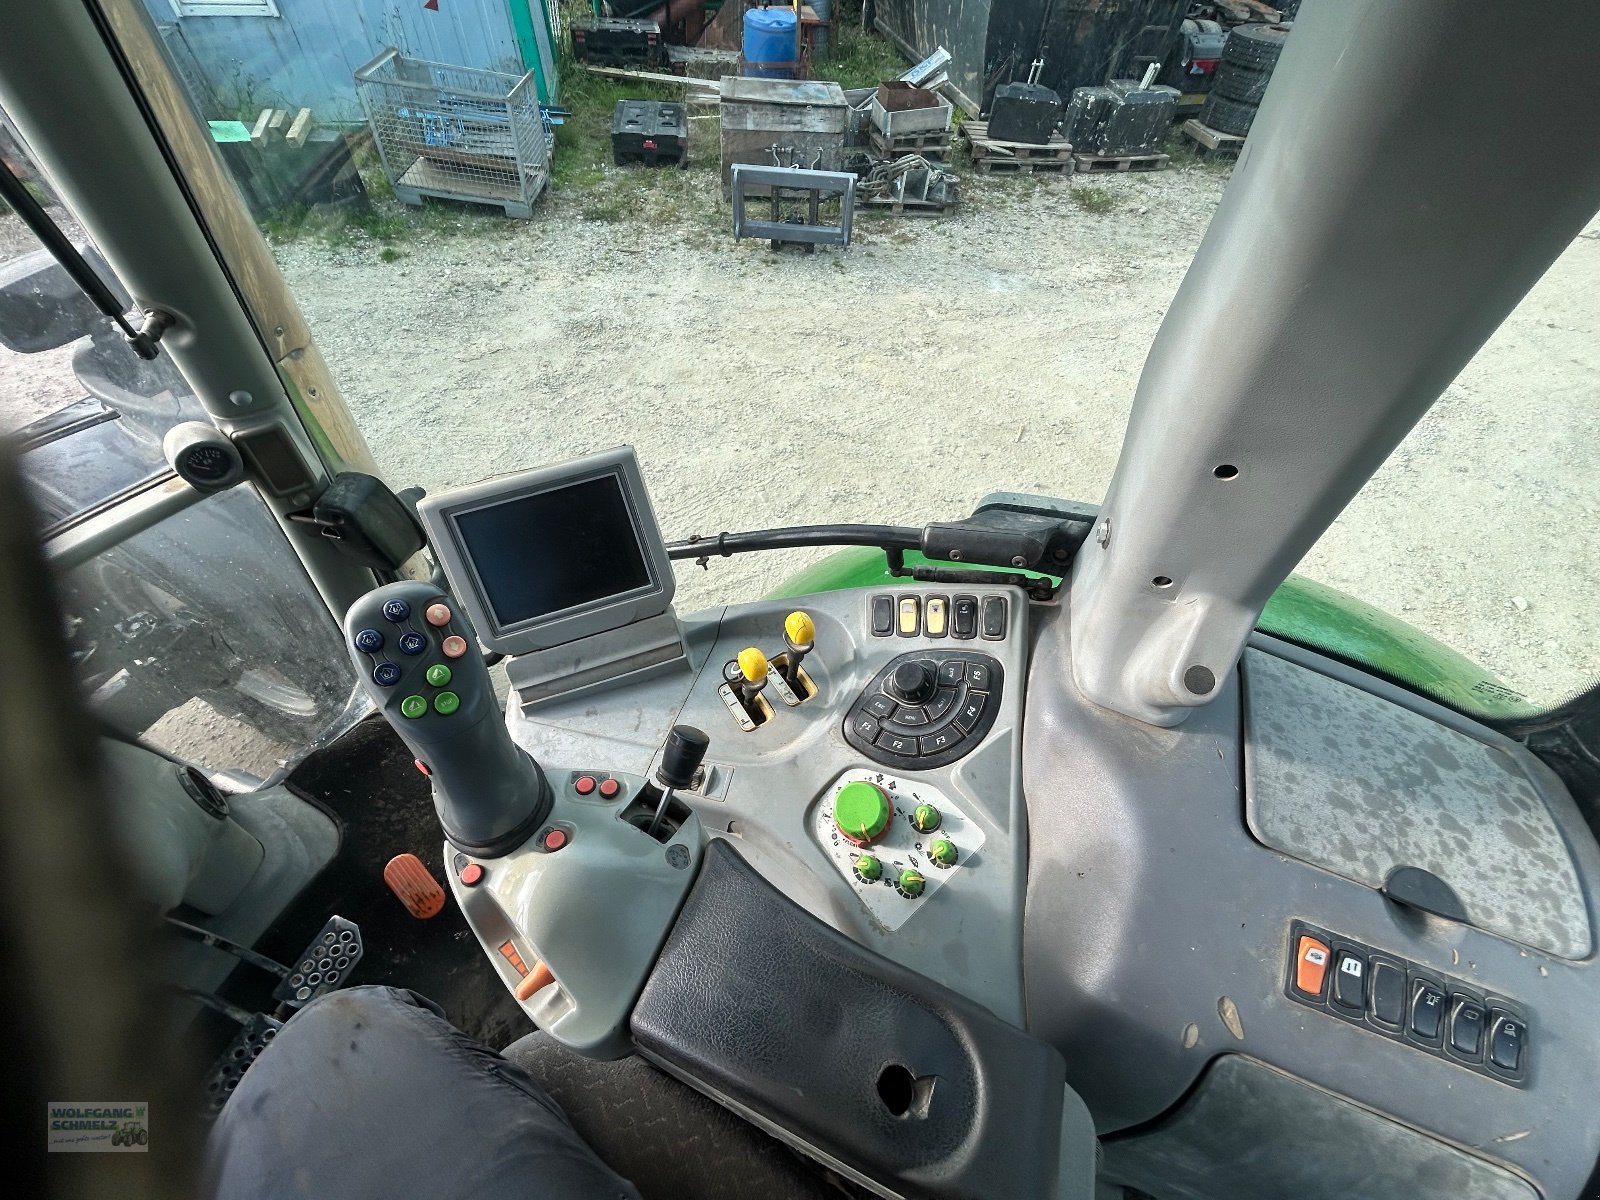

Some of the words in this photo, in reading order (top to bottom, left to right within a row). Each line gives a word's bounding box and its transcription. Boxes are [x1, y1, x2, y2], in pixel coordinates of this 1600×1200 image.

[973, 670, 981, 680] F5
[967, 706, 976, 717] F4
[861, 721, 872, 731] F1
[892, 740, 903, 749] F2
[936, 736, 946, 745] F3
